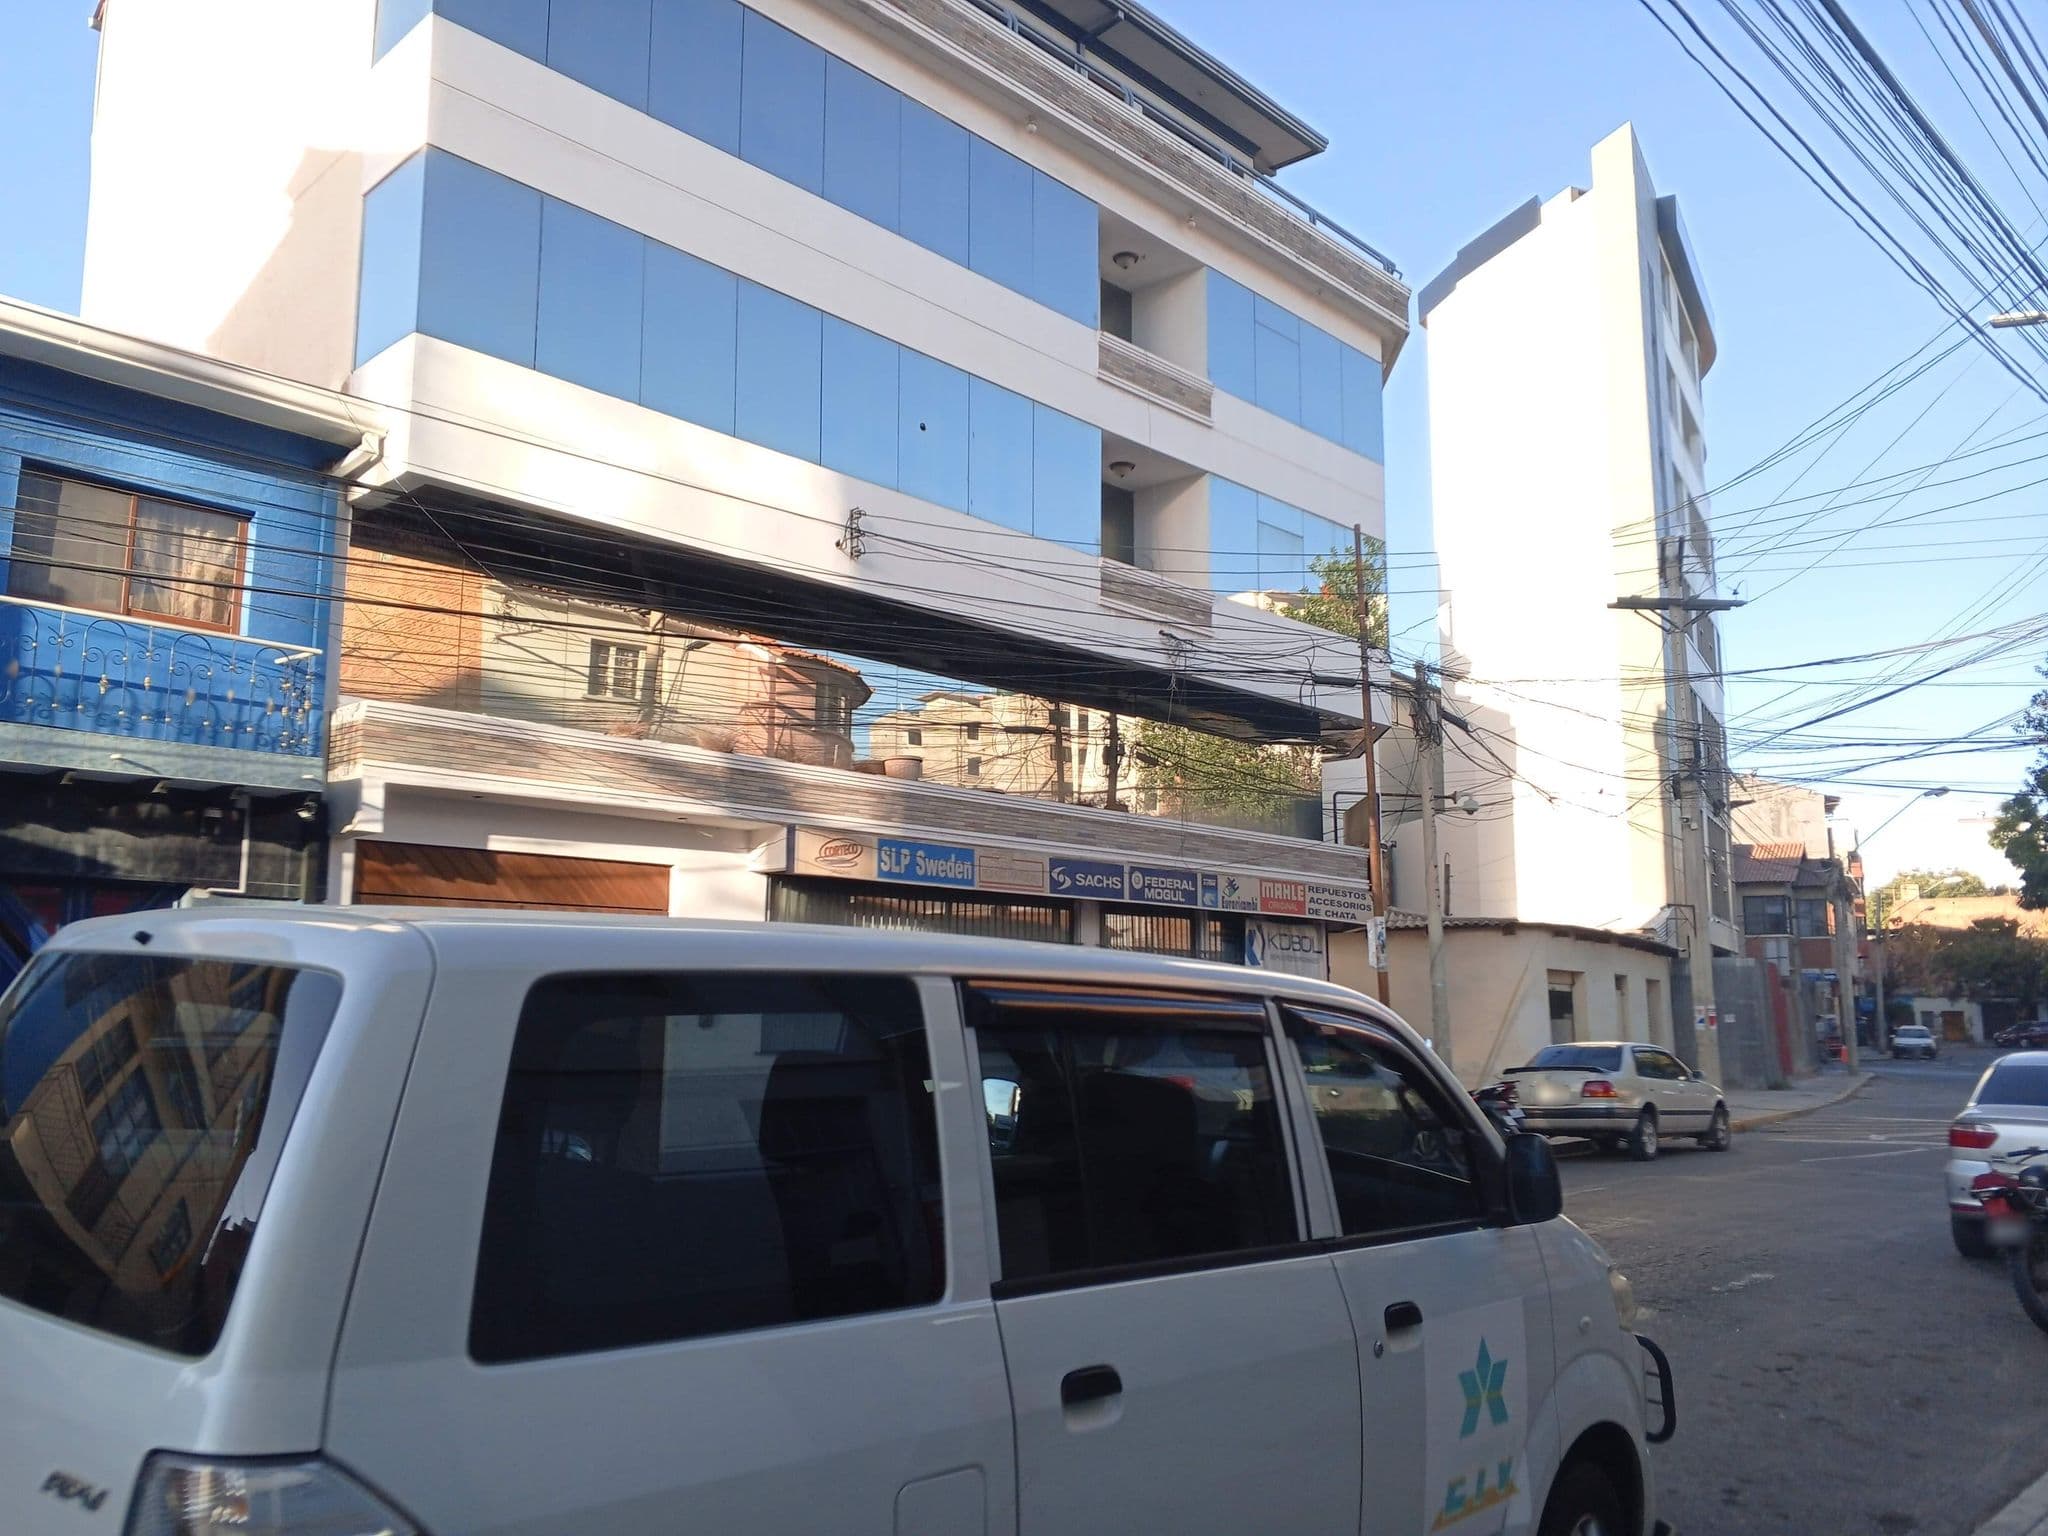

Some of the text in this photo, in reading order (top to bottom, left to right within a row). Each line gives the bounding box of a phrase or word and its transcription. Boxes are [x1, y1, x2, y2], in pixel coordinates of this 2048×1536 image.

[824, 843, 858, 857] CORTECO
[880, 846, 911, 874] SLP
[915, 849, 974, 880] Sweden
[1075, 873, 1122, 889] SACHS
[1144, 876, 1195, 891] FEDERAL
[1144, 888, 1185, 902] MOGUL
[1262, 881, 1305, 901] MAHLE
[1308, 885, 1367, 901] REPUESTOS
[1308, 896, 1373, 912] ACCESORIOS
[1308, 908, 1357, 920] DE CHATA
[1268, 932, 1322, 954] KOBOL
